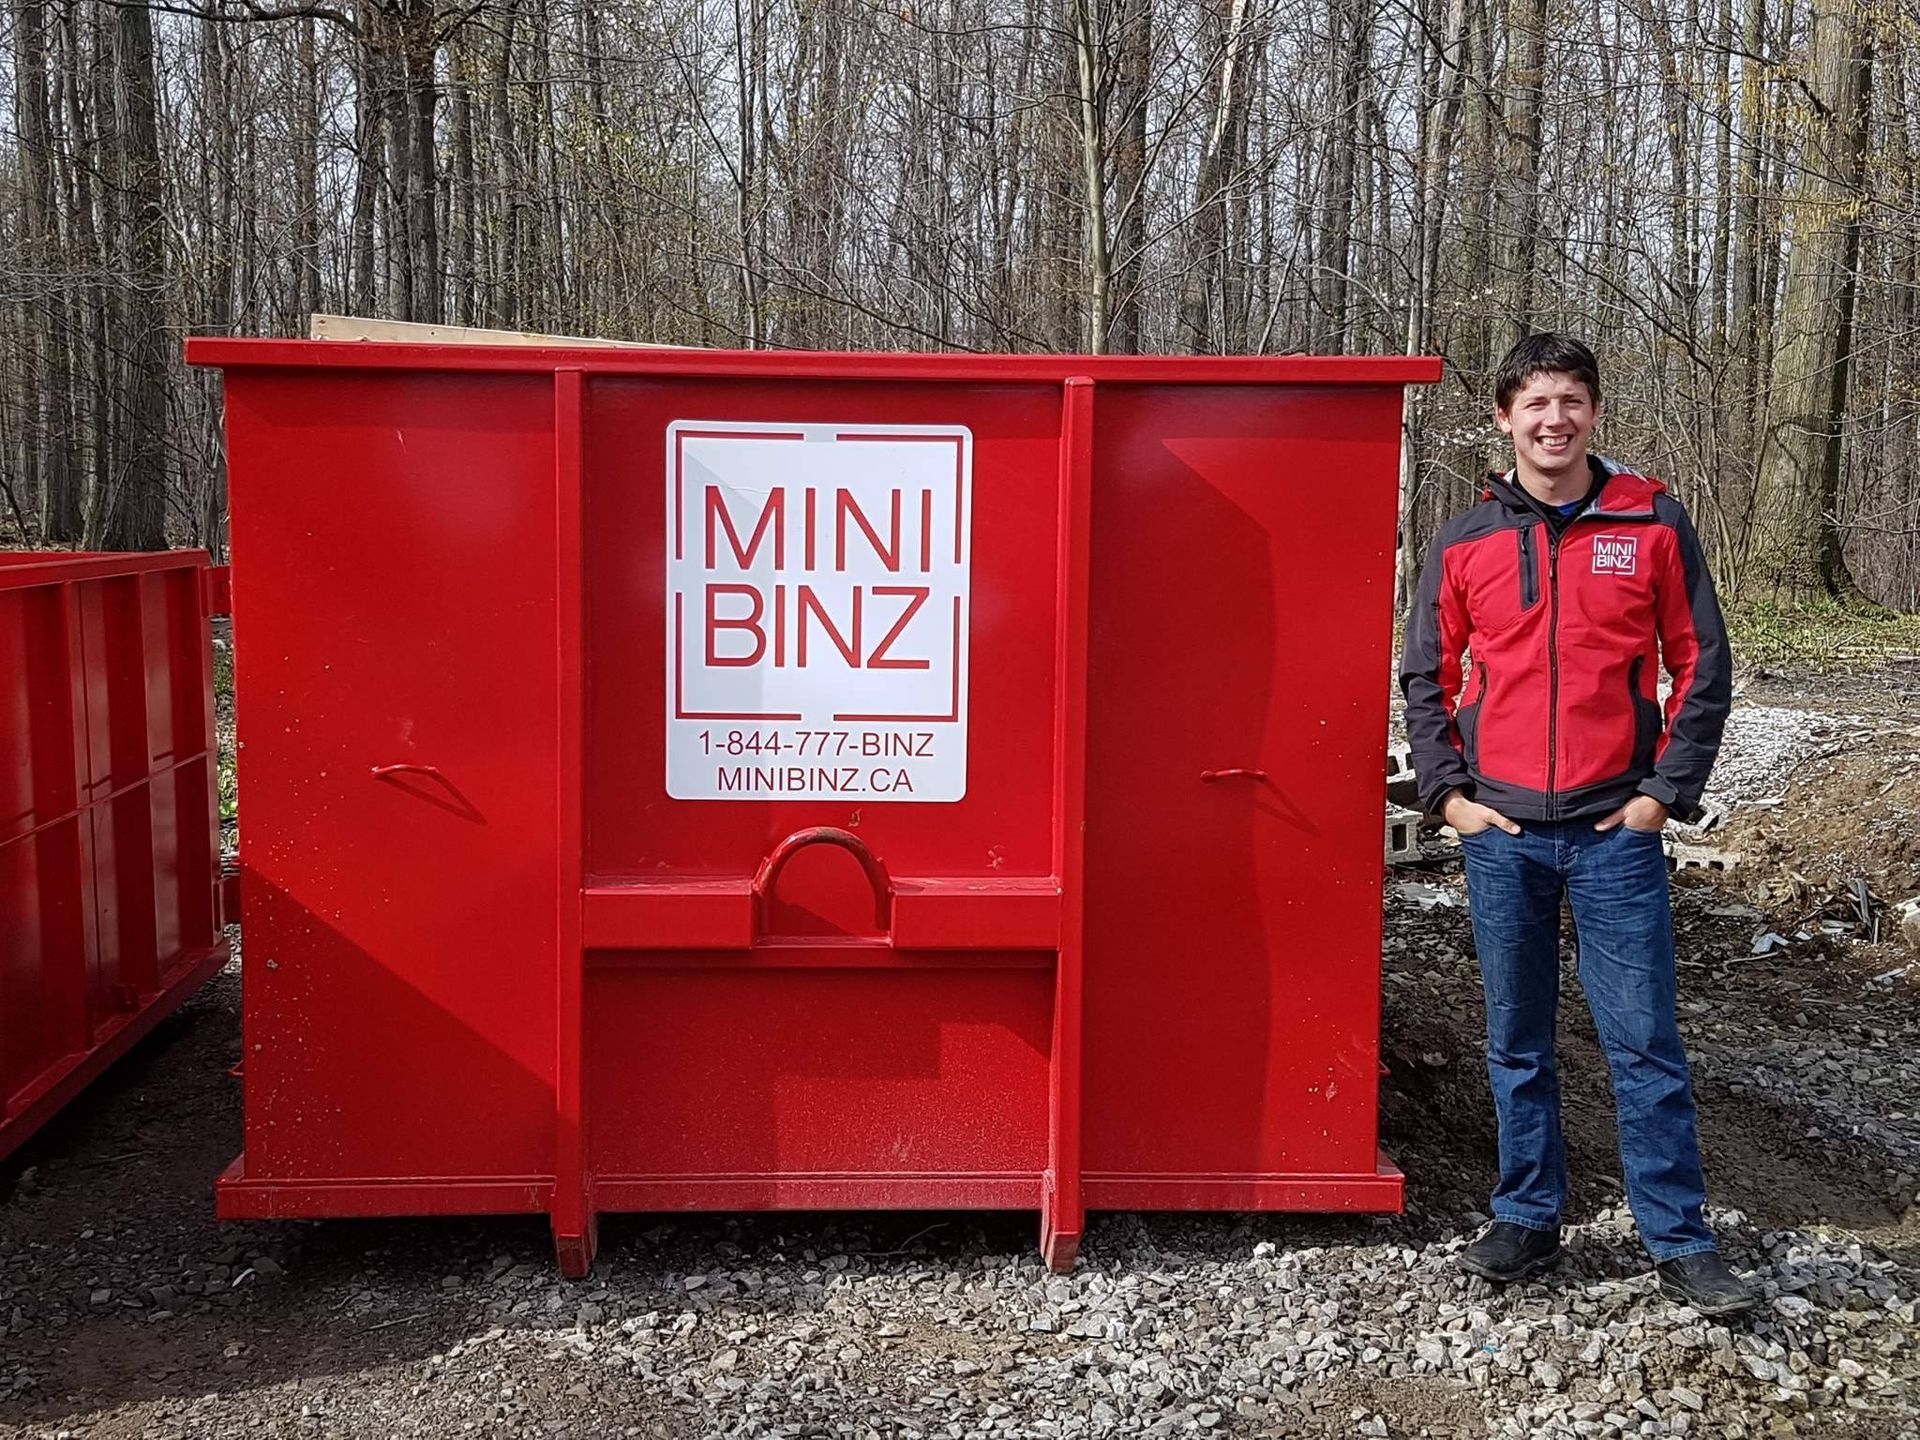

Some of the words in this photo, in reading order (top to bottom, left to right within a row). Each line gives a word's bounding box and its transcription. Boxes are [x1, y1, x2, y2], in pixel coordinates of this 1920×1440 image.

[705, 485, 931, 572] MINI
[1597, 554, 1632, 569] BINZ
[1598, 541, 1632, 556] MINI
[705, 583, 930, 669] BINZ
[699, 731, 934, 757] 1-844-777-BINZ
[717, 766, 913, 792] MINIBINZ.CA
